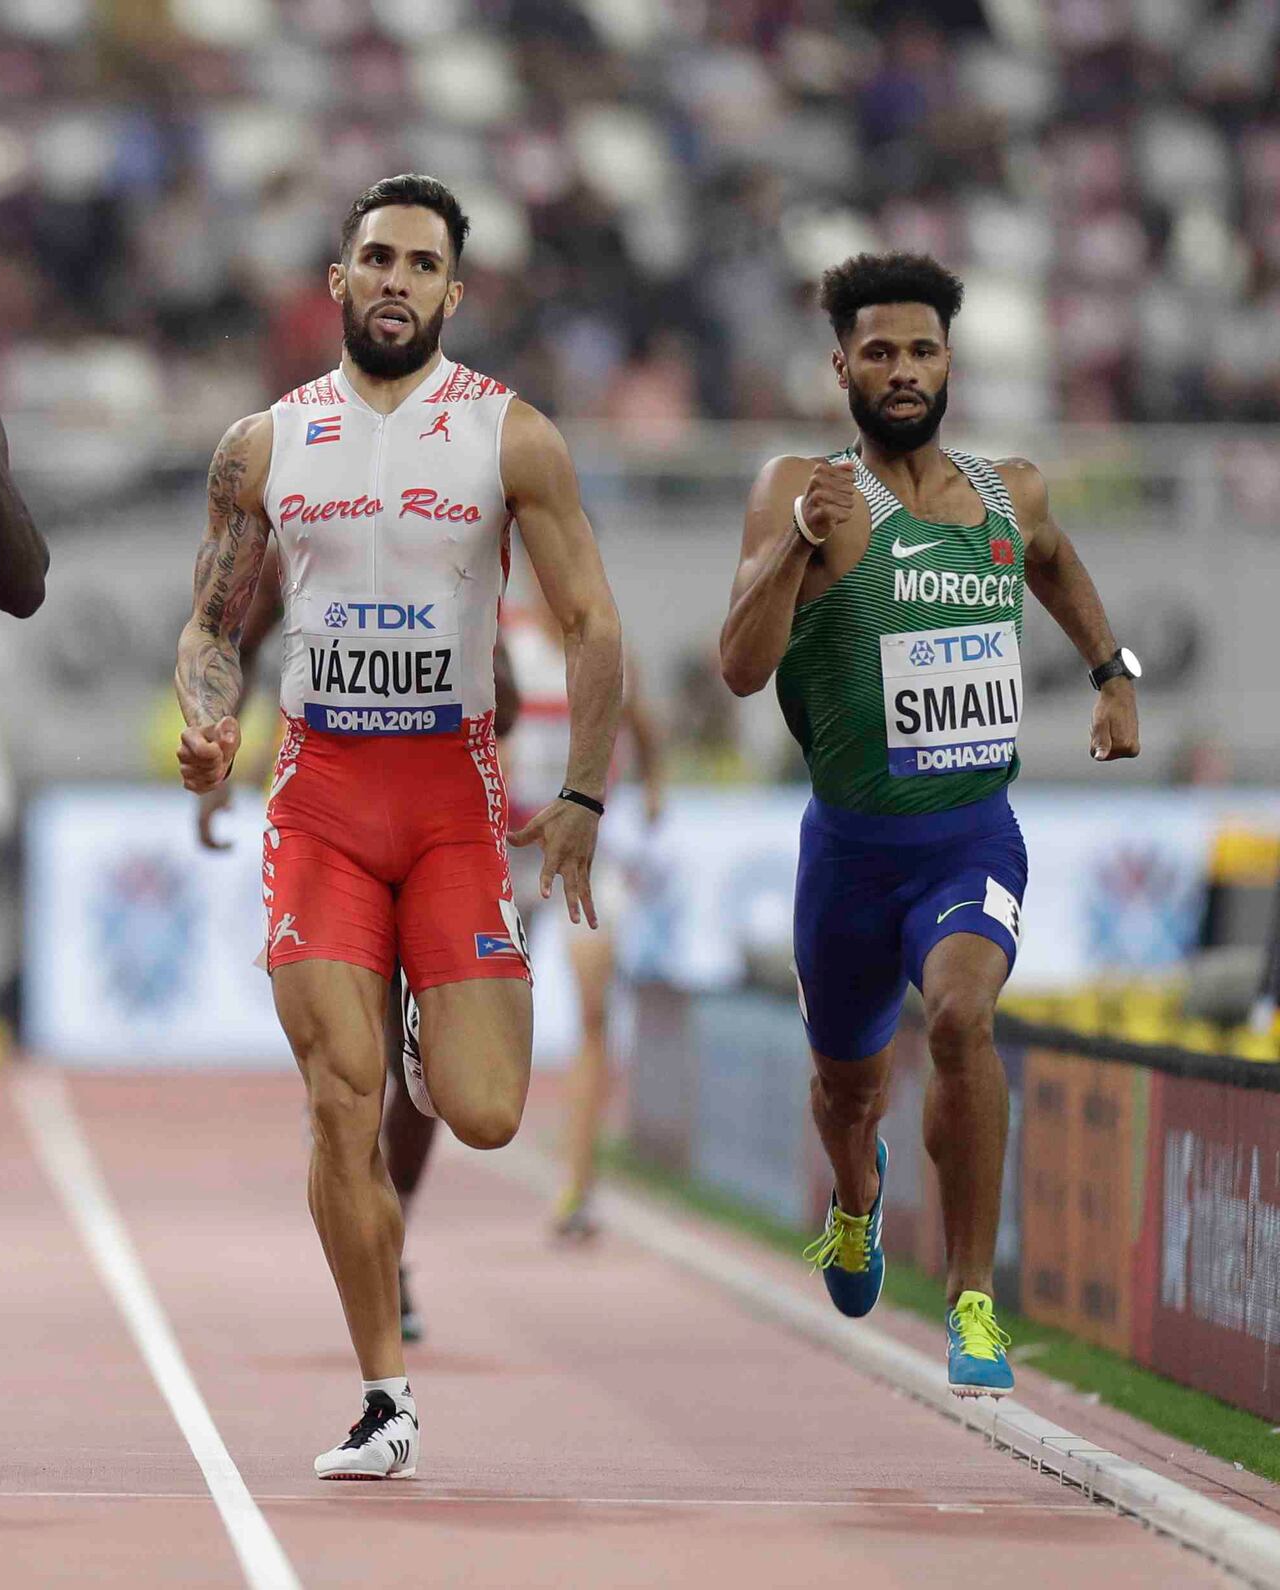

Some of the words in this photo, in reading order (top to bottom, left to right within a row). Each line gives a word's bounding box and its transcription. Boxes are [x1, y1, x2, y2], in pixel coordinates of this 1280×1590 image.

[279, 492, 385, 531] Puerto
[398, 487, 482, 525] Rico
[348, 602, 437, 631] TDK
[933, 631, 1004, 664] TDK
[308, 638, 453, 699] VÁZQUEZ
[326, 707, 437, 732] DOHA2019
[894, 678, 1018, 736] SMAILI
